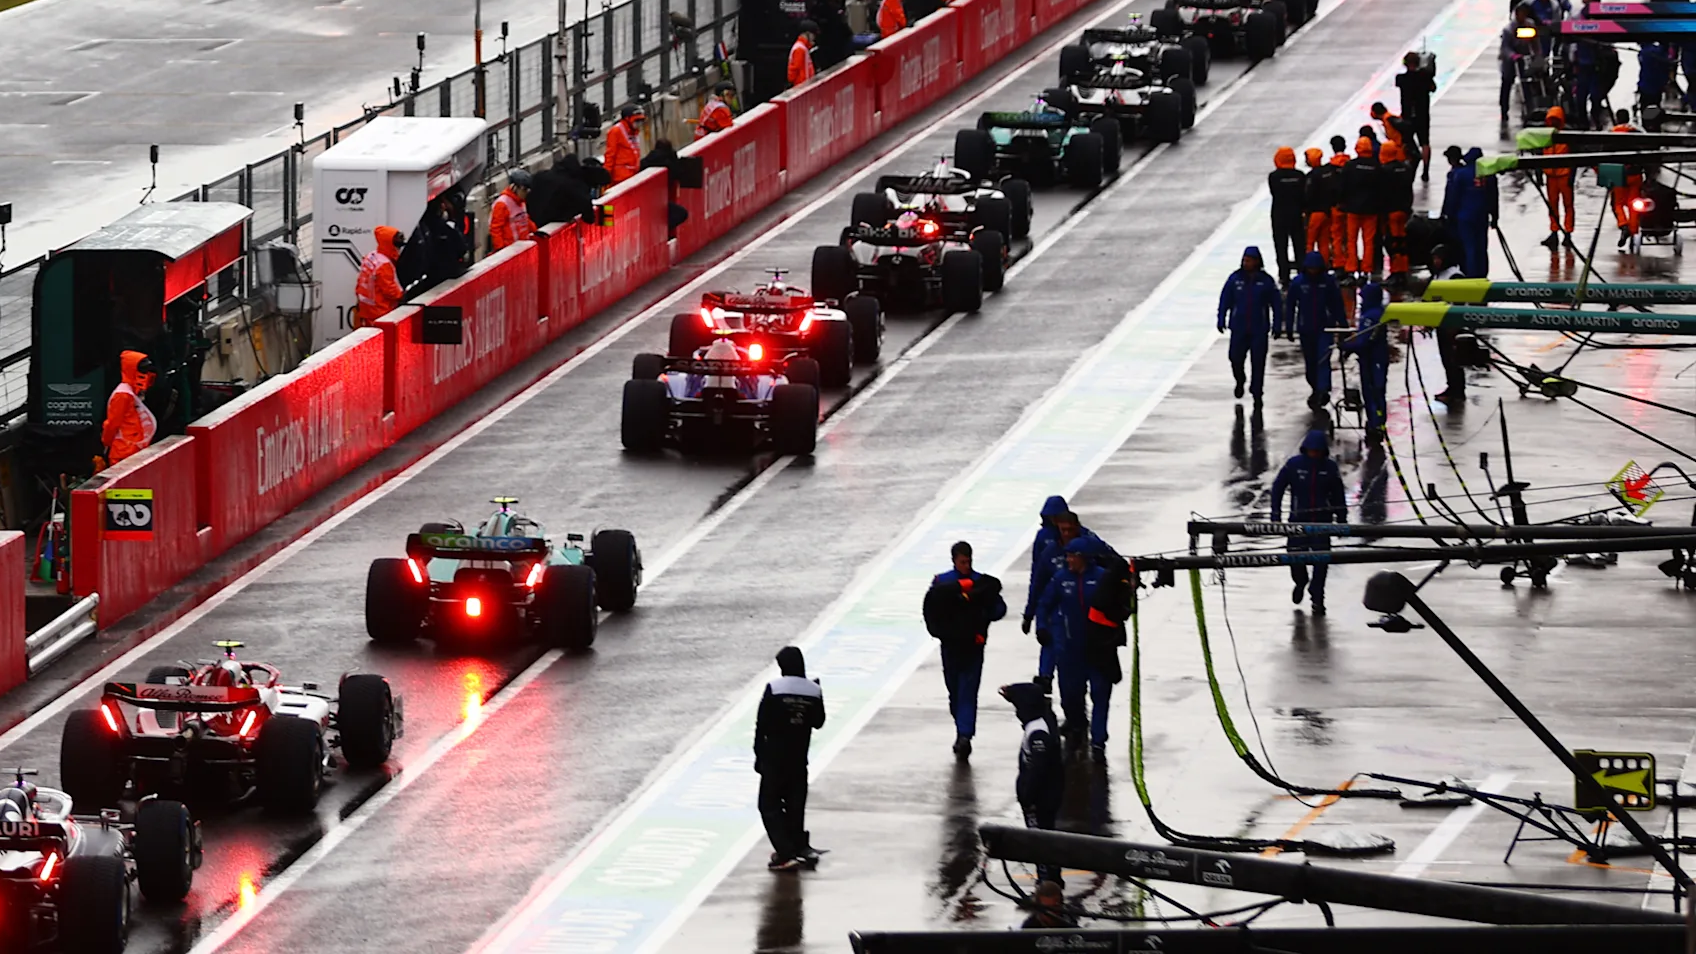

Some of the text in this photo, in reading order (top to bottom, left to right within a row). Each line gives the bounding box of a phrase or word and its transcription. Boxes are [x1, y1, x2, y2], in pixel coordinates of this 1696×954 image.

[1505, 287, 1553, 297] aramco
[1565, 288, 1604, 298] ASON
[1609, 288, 1654, 298] MARTIN
[1463, 312, 1680, 329] cognizant ASTON MARTIN aramco
[47, 401, 92, 411] cognizant
[1244, 524, 1303, 535] WILLIAMS
[427, 536, 526, 550] aramco
[140, 688, 223, 700] Alfa Romeo
